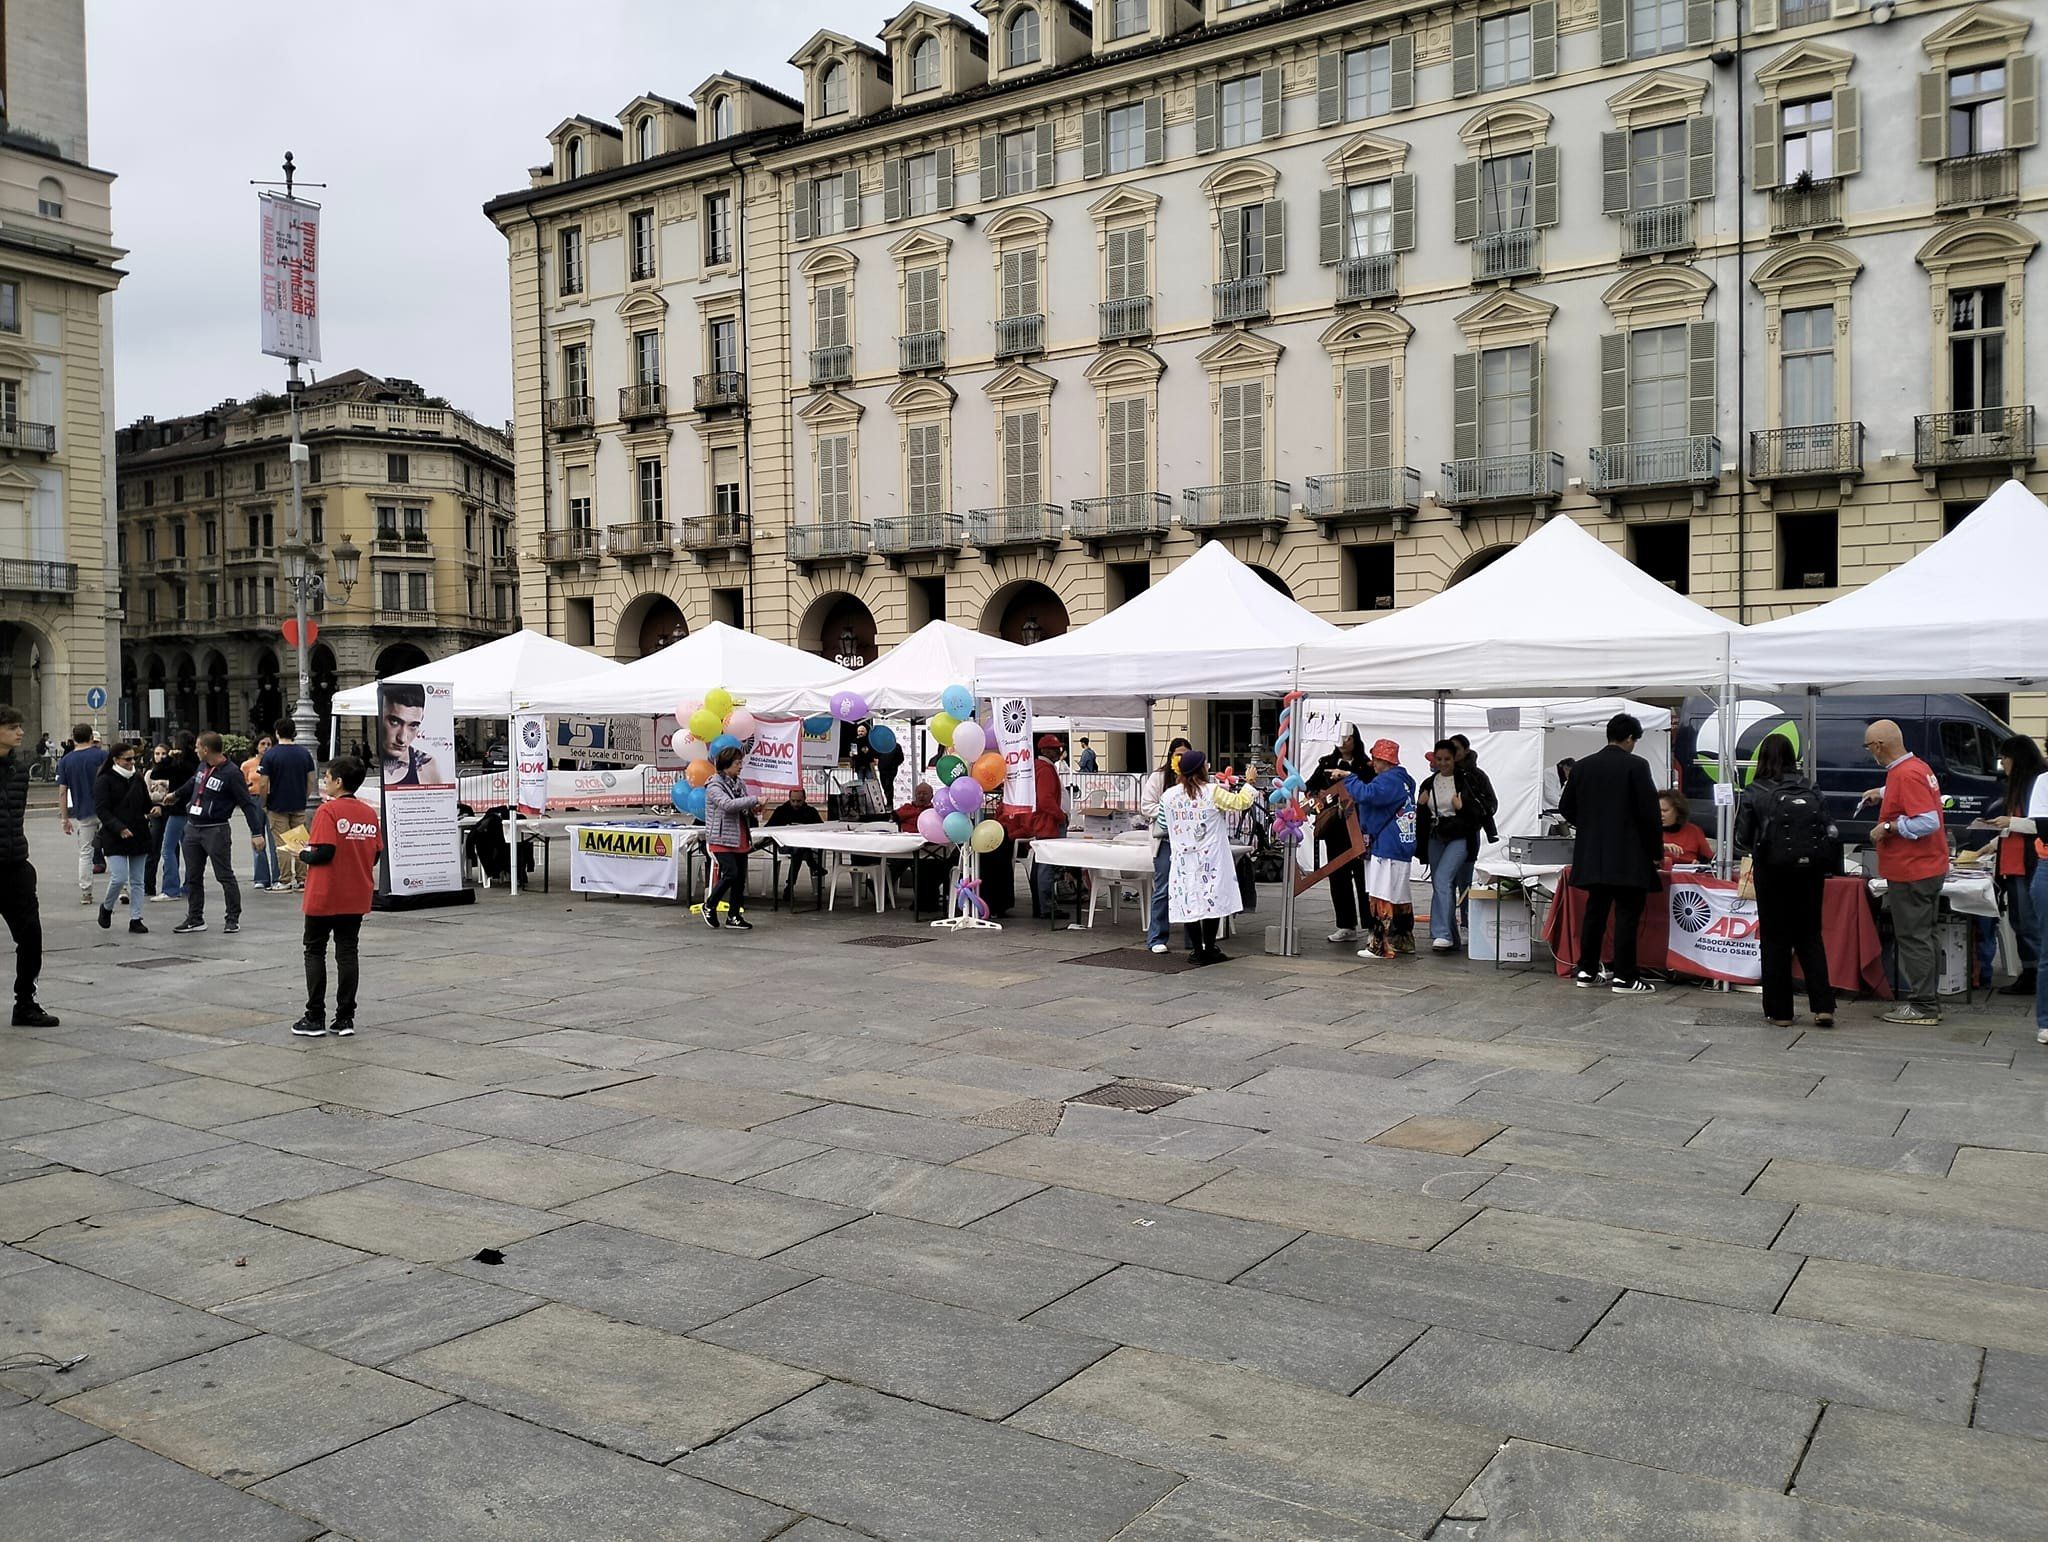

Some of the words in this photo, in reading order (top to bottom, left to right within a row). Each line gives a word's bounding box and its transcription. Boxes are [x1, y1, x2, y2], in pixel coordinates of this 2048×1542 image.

[835, 654, 864, 667] Sella
[570, 748, 586, 757] Sede
[588, 750, 610, 759] Locale
[612, 751, 618, 760] di
[620, 752, 644, 761] Torino
[752, 740, 794, 759] ADMO
[350, 823, 377, 833] ADMO
[585, 832, 651, 854] AMAMI
[1697, 937, 1757, 949] ASSOCIAZIONE
[1694, 943, 1728, 953] MIDOLLO
[1729, 948, 1758, 957] OSSEO
